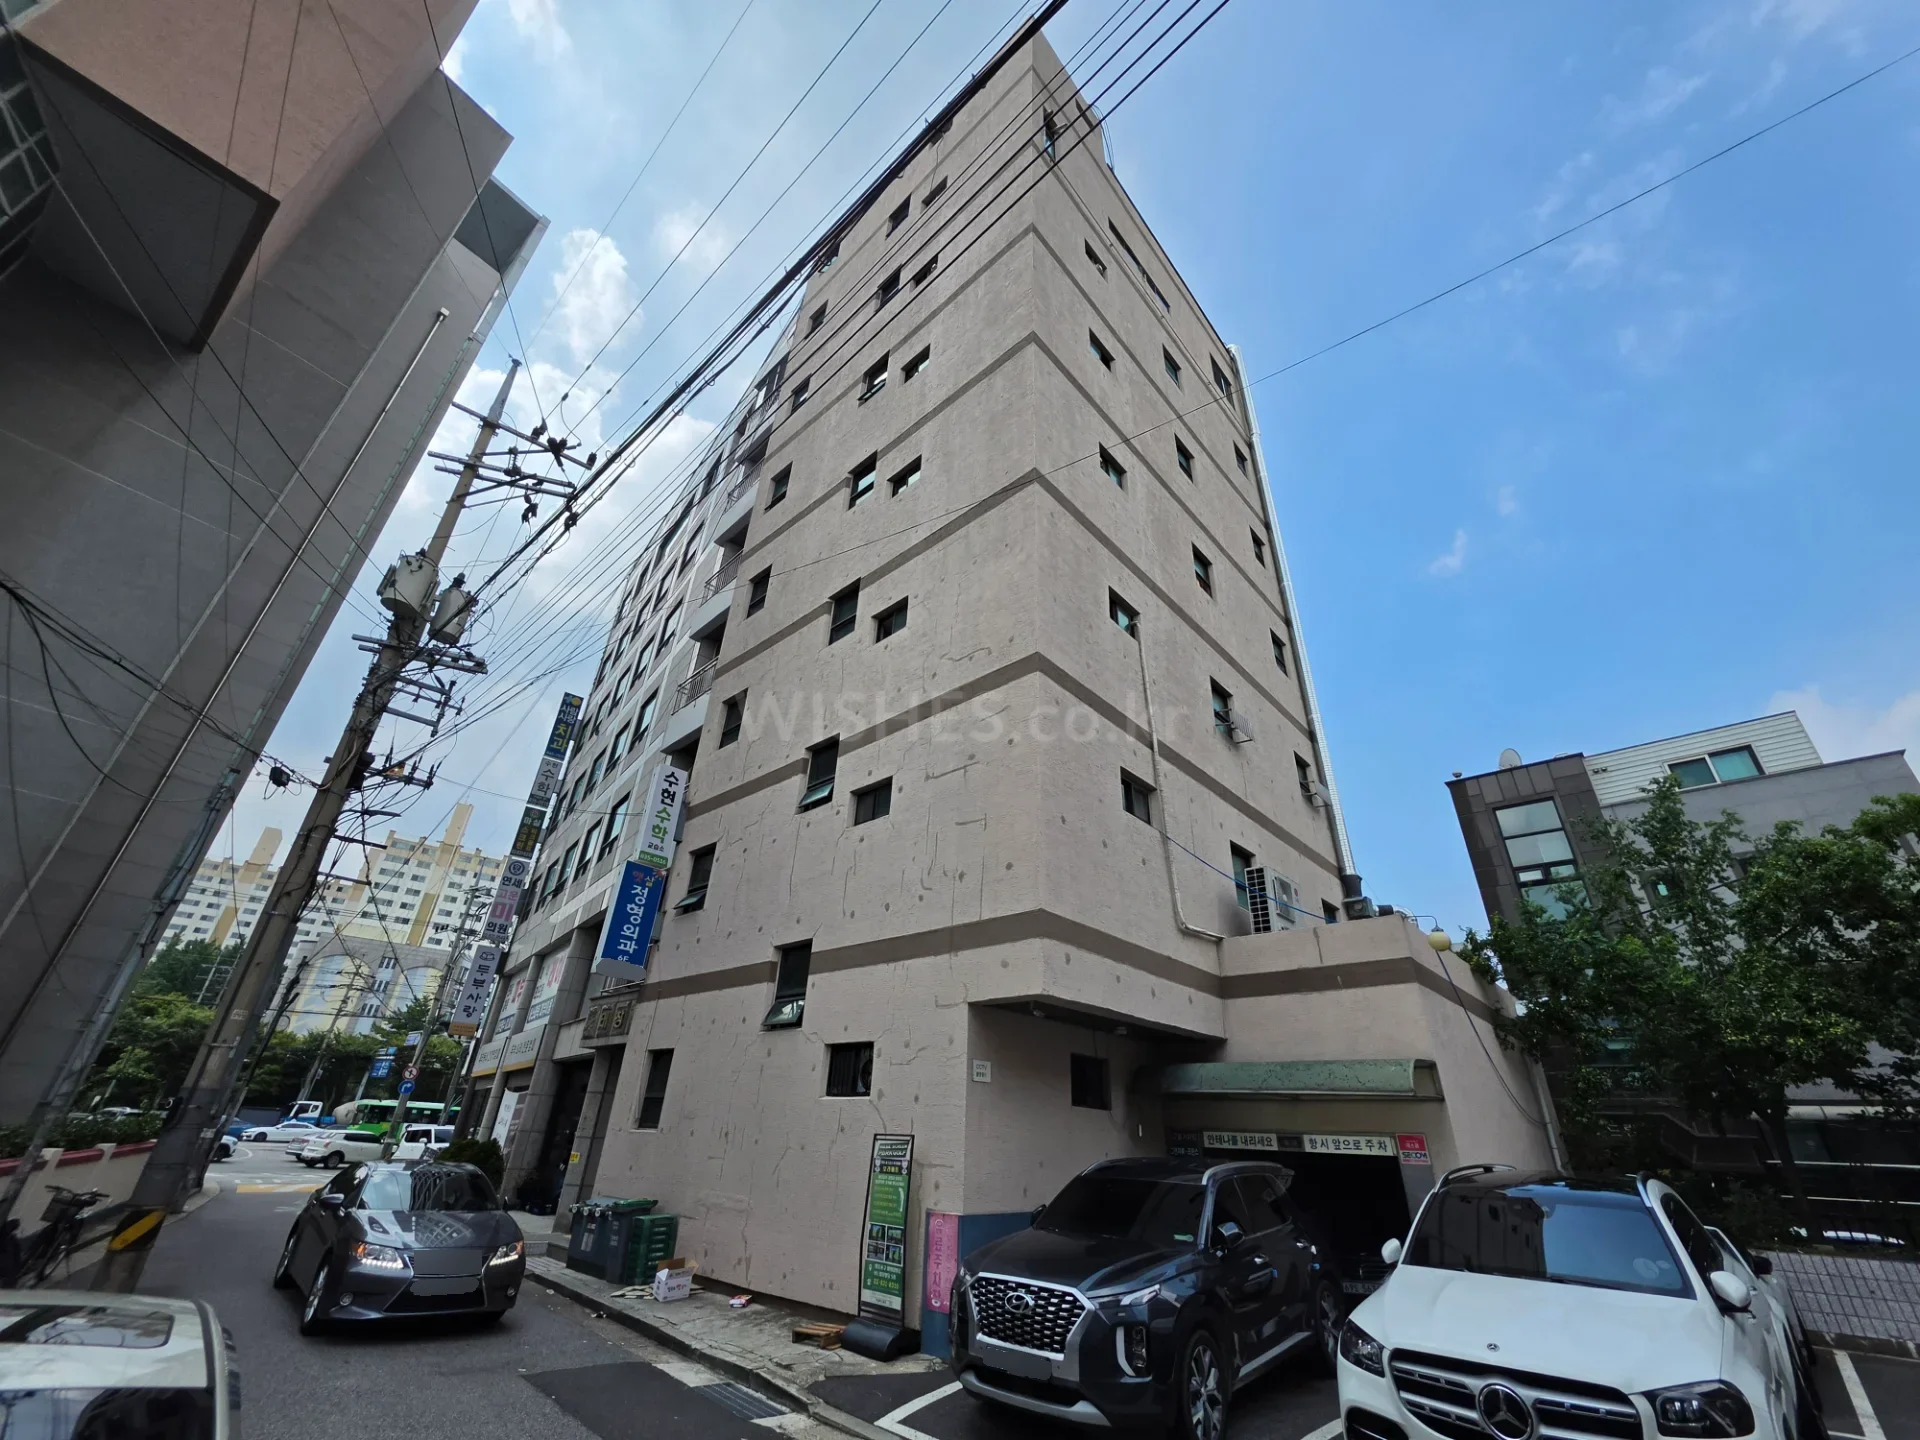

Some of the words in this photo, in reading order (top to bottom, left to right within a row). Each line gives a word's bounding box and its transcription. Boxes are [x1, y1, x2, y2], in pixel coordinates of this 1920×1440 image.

[550, 723, 572, 753] 치과
[537, 768, 555, 796] 수학
[502, 875, 524, 889] 연세
[617, 884, 649, 955] 정형외과
[485, 921, 509, 935] 의원
[462, 963, 491, 1019] 두부사랑
[1206, 1133, 1239, 1146] 안테나를
[1240, 1134, 1274, 1147] 내리세요
[1308, 1137, 1330, 1150] 항시
[1401, 1151, 1428, 1160] SECOM
